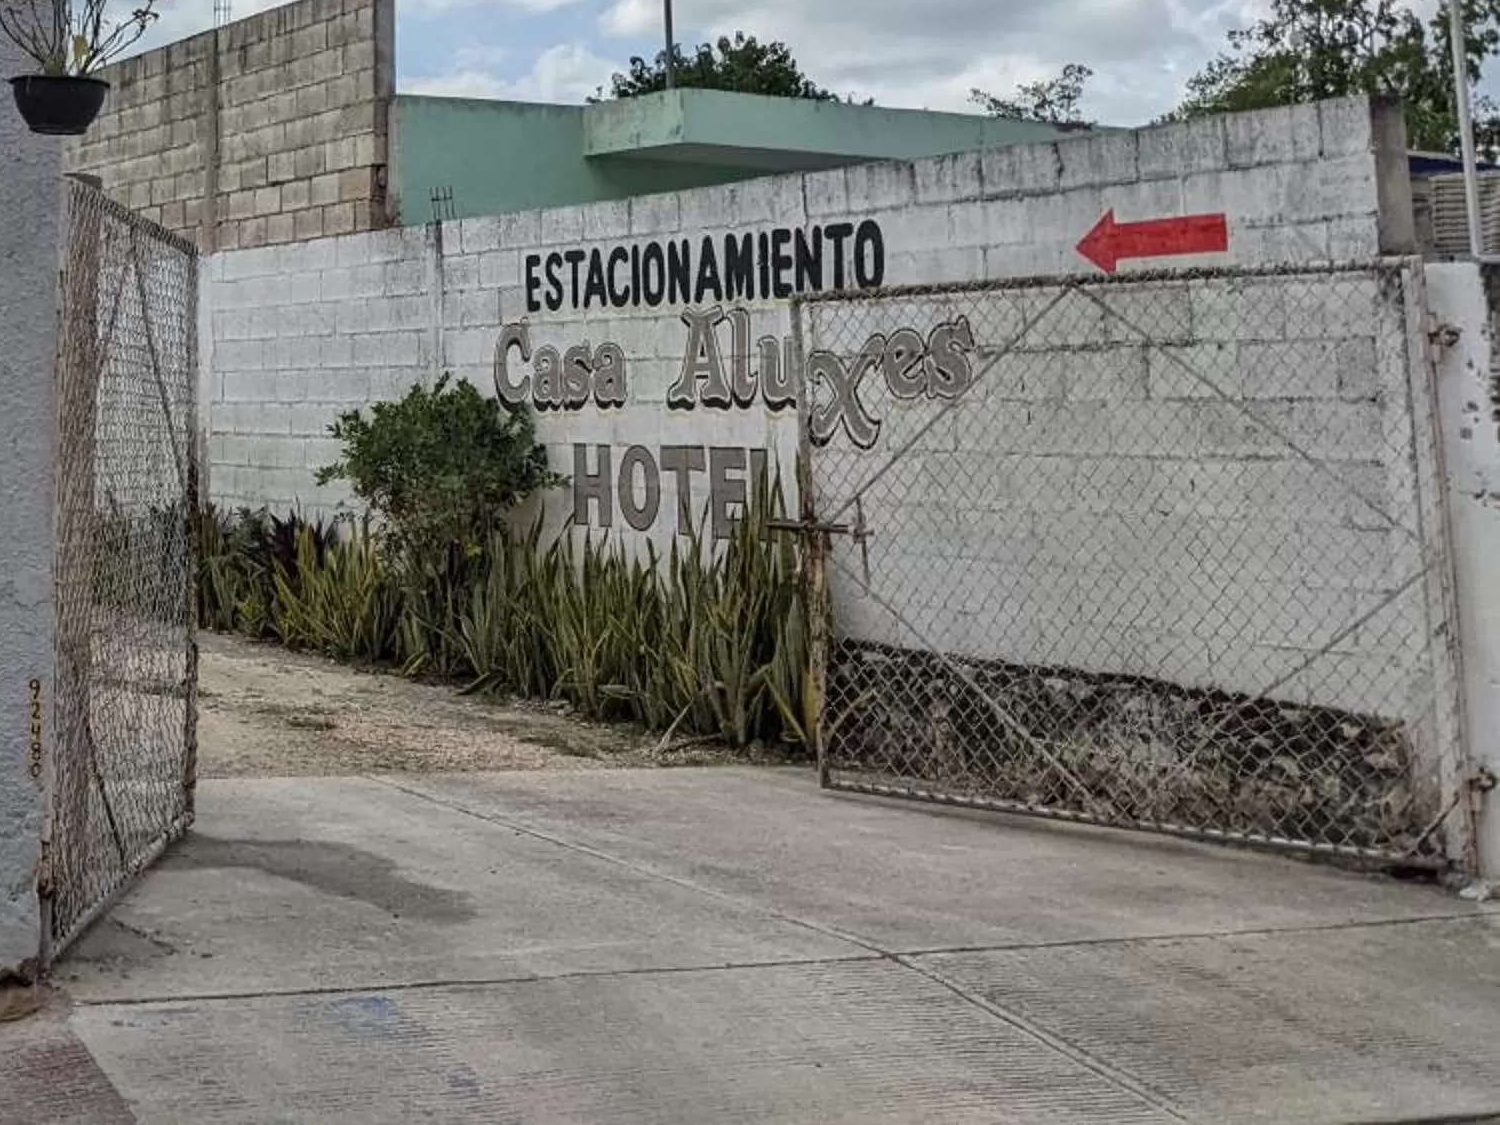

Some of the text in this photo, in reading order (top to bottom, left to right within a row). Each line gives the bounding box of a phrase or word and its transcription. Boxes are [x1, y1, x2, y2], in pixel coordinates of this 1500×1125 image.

[525, 219, 885, 312] ESTACIONAMIENTO
[494, 305, 975, 449] Casa Aluxes
